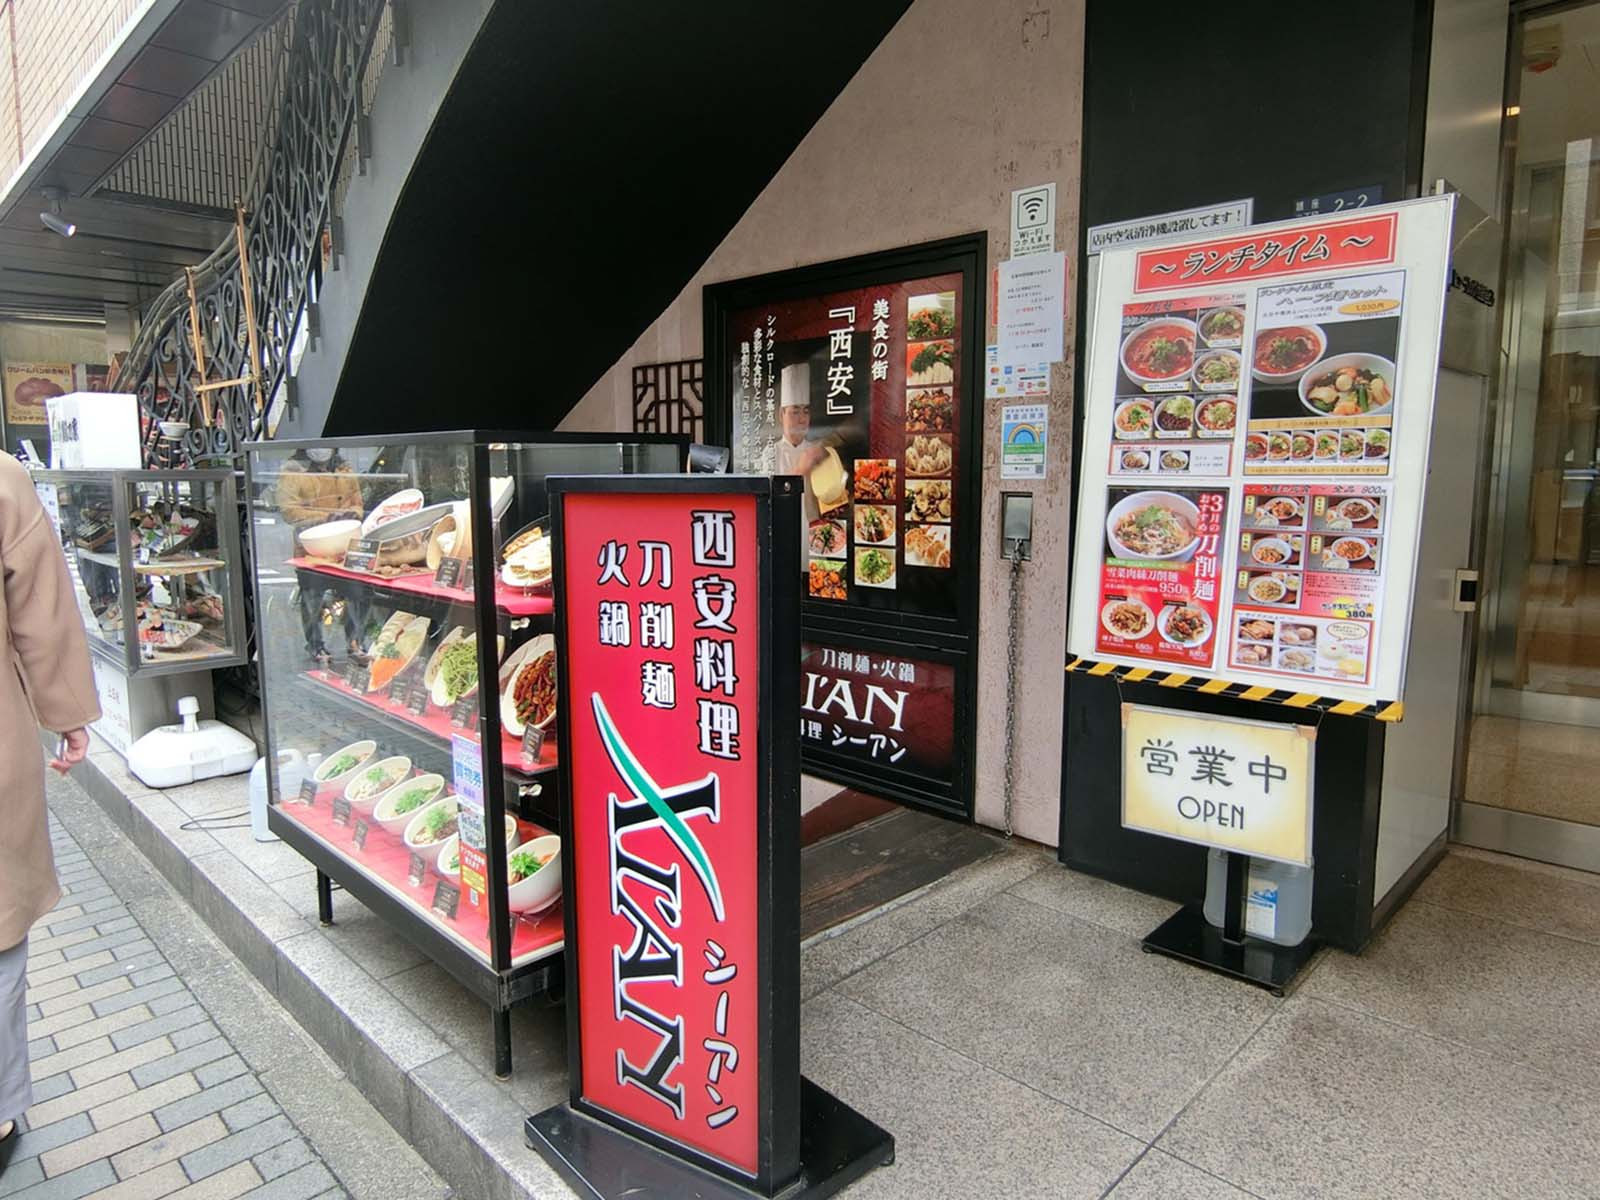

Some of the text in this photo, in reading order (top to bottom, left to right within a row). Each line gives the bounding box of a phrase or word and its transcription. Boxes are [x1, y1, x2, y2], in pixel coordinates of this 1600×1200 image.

[871, 298, 890, 381] 美食の街
[597, 539, 632, 648] 火鍋
[1193, 533, 1219, 601] 刀削麺
[638, 540, 676, 709] 刀削麺
[691, 510, 741, 760] 西安料理
[822, 648, 915, 684] 刀削麺・火鍋
[832, 723, 907, 763] シーアン
[1140, 738, 1288, 794] 営業中
[1177, 796, 1245, 831] OPEN
[703, 938, 740, 1130] シーアン
